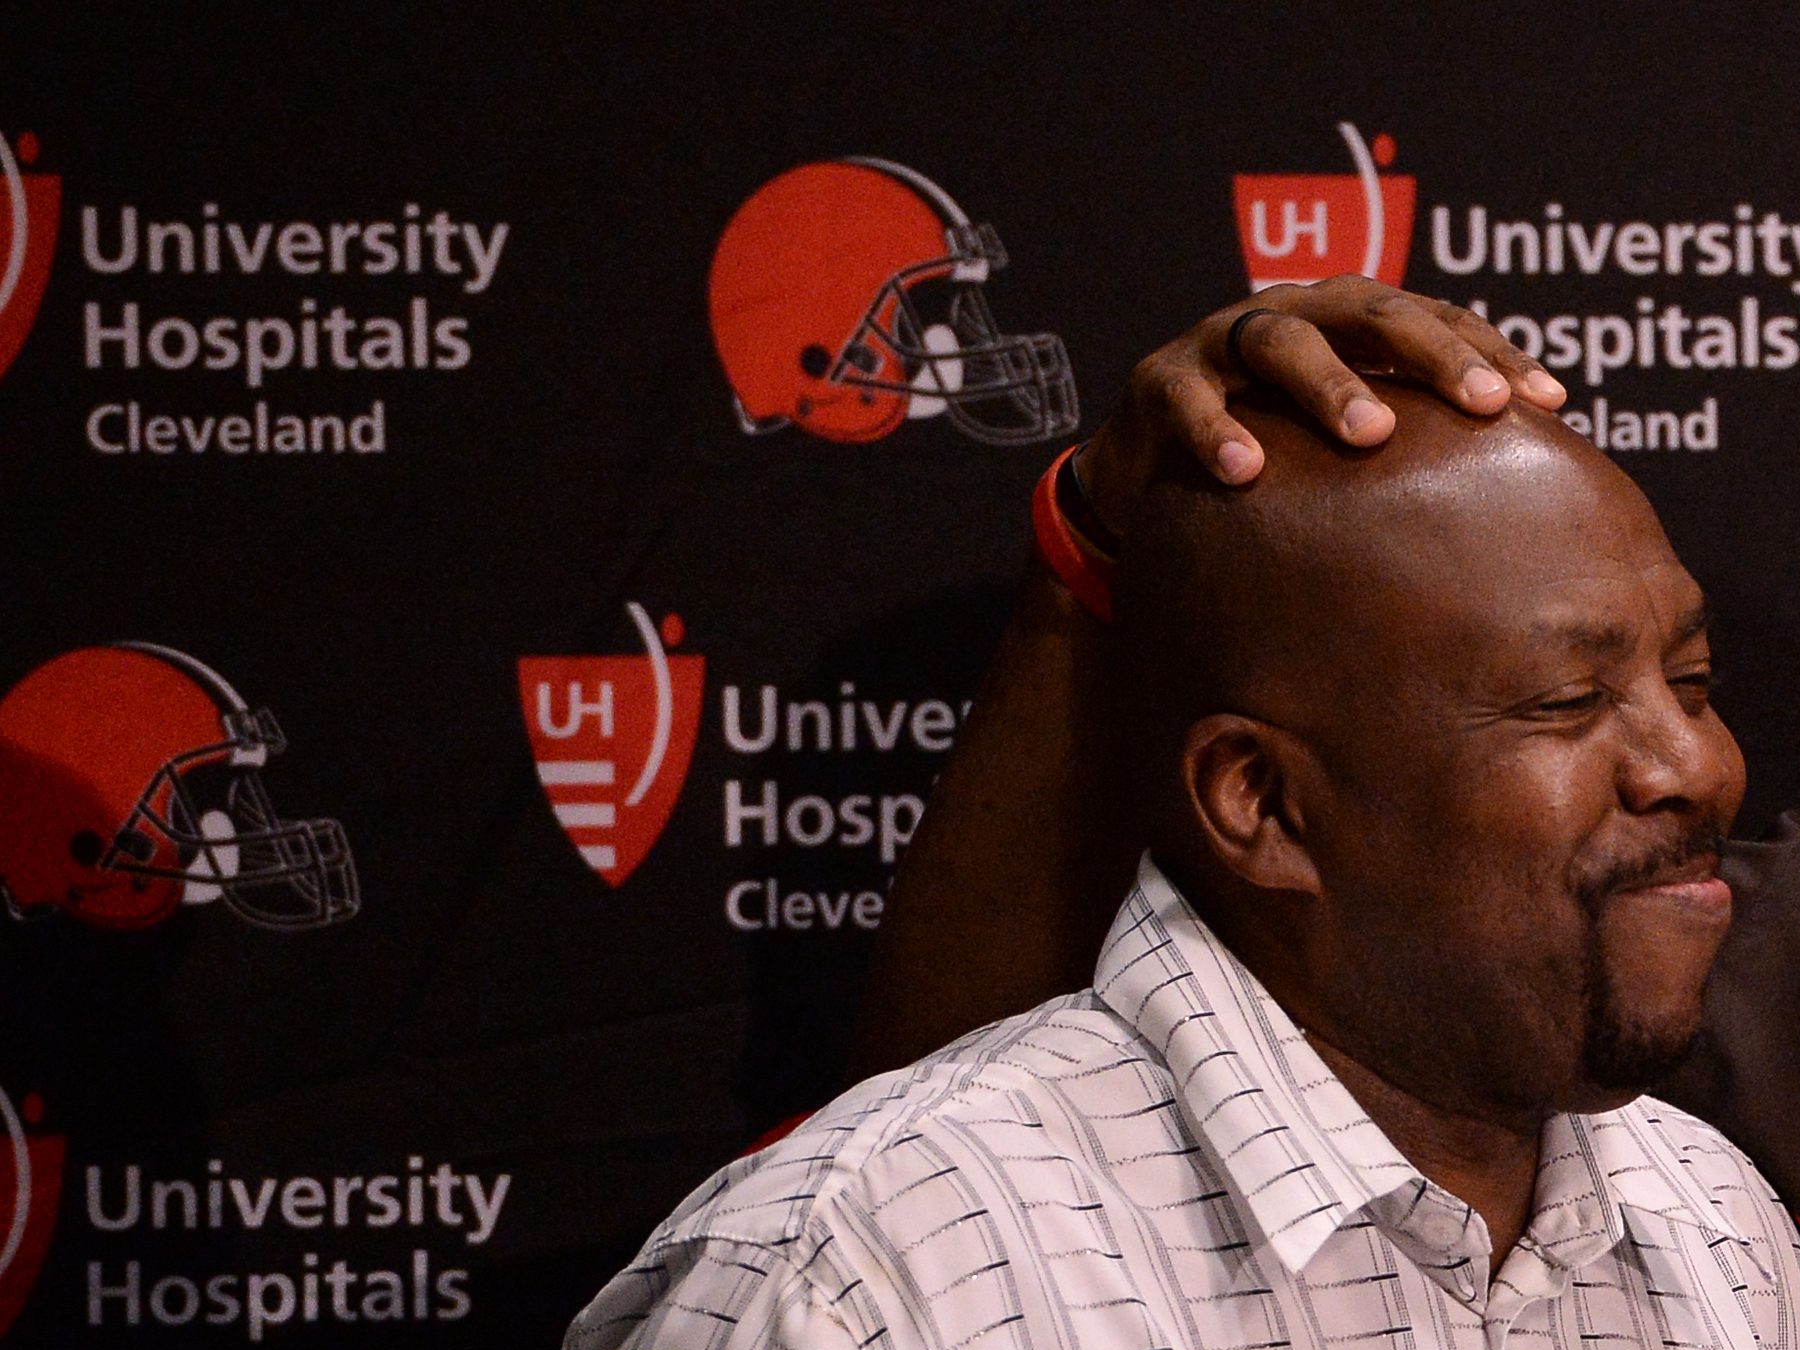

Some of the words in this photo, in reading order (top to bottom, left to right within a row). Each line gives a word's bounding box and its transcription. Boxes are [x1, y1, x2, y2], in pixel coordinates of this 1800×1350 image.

[82, 203, 510, 294] University
[1251, 200, 1328, 259] UH
[84, 297, 471, 388] Hospitals
[86, 400, 386, 454] Cleveland
[536, 681, 615, 739] UH
[722, 681, 973, 753] Unive
[724, 773, 940, 864] Hosp
[725, 876, 895, 930] Cleve
[87, 1155, 512, 1244] University
[89, 1249, 470, 1341] Hospitals
